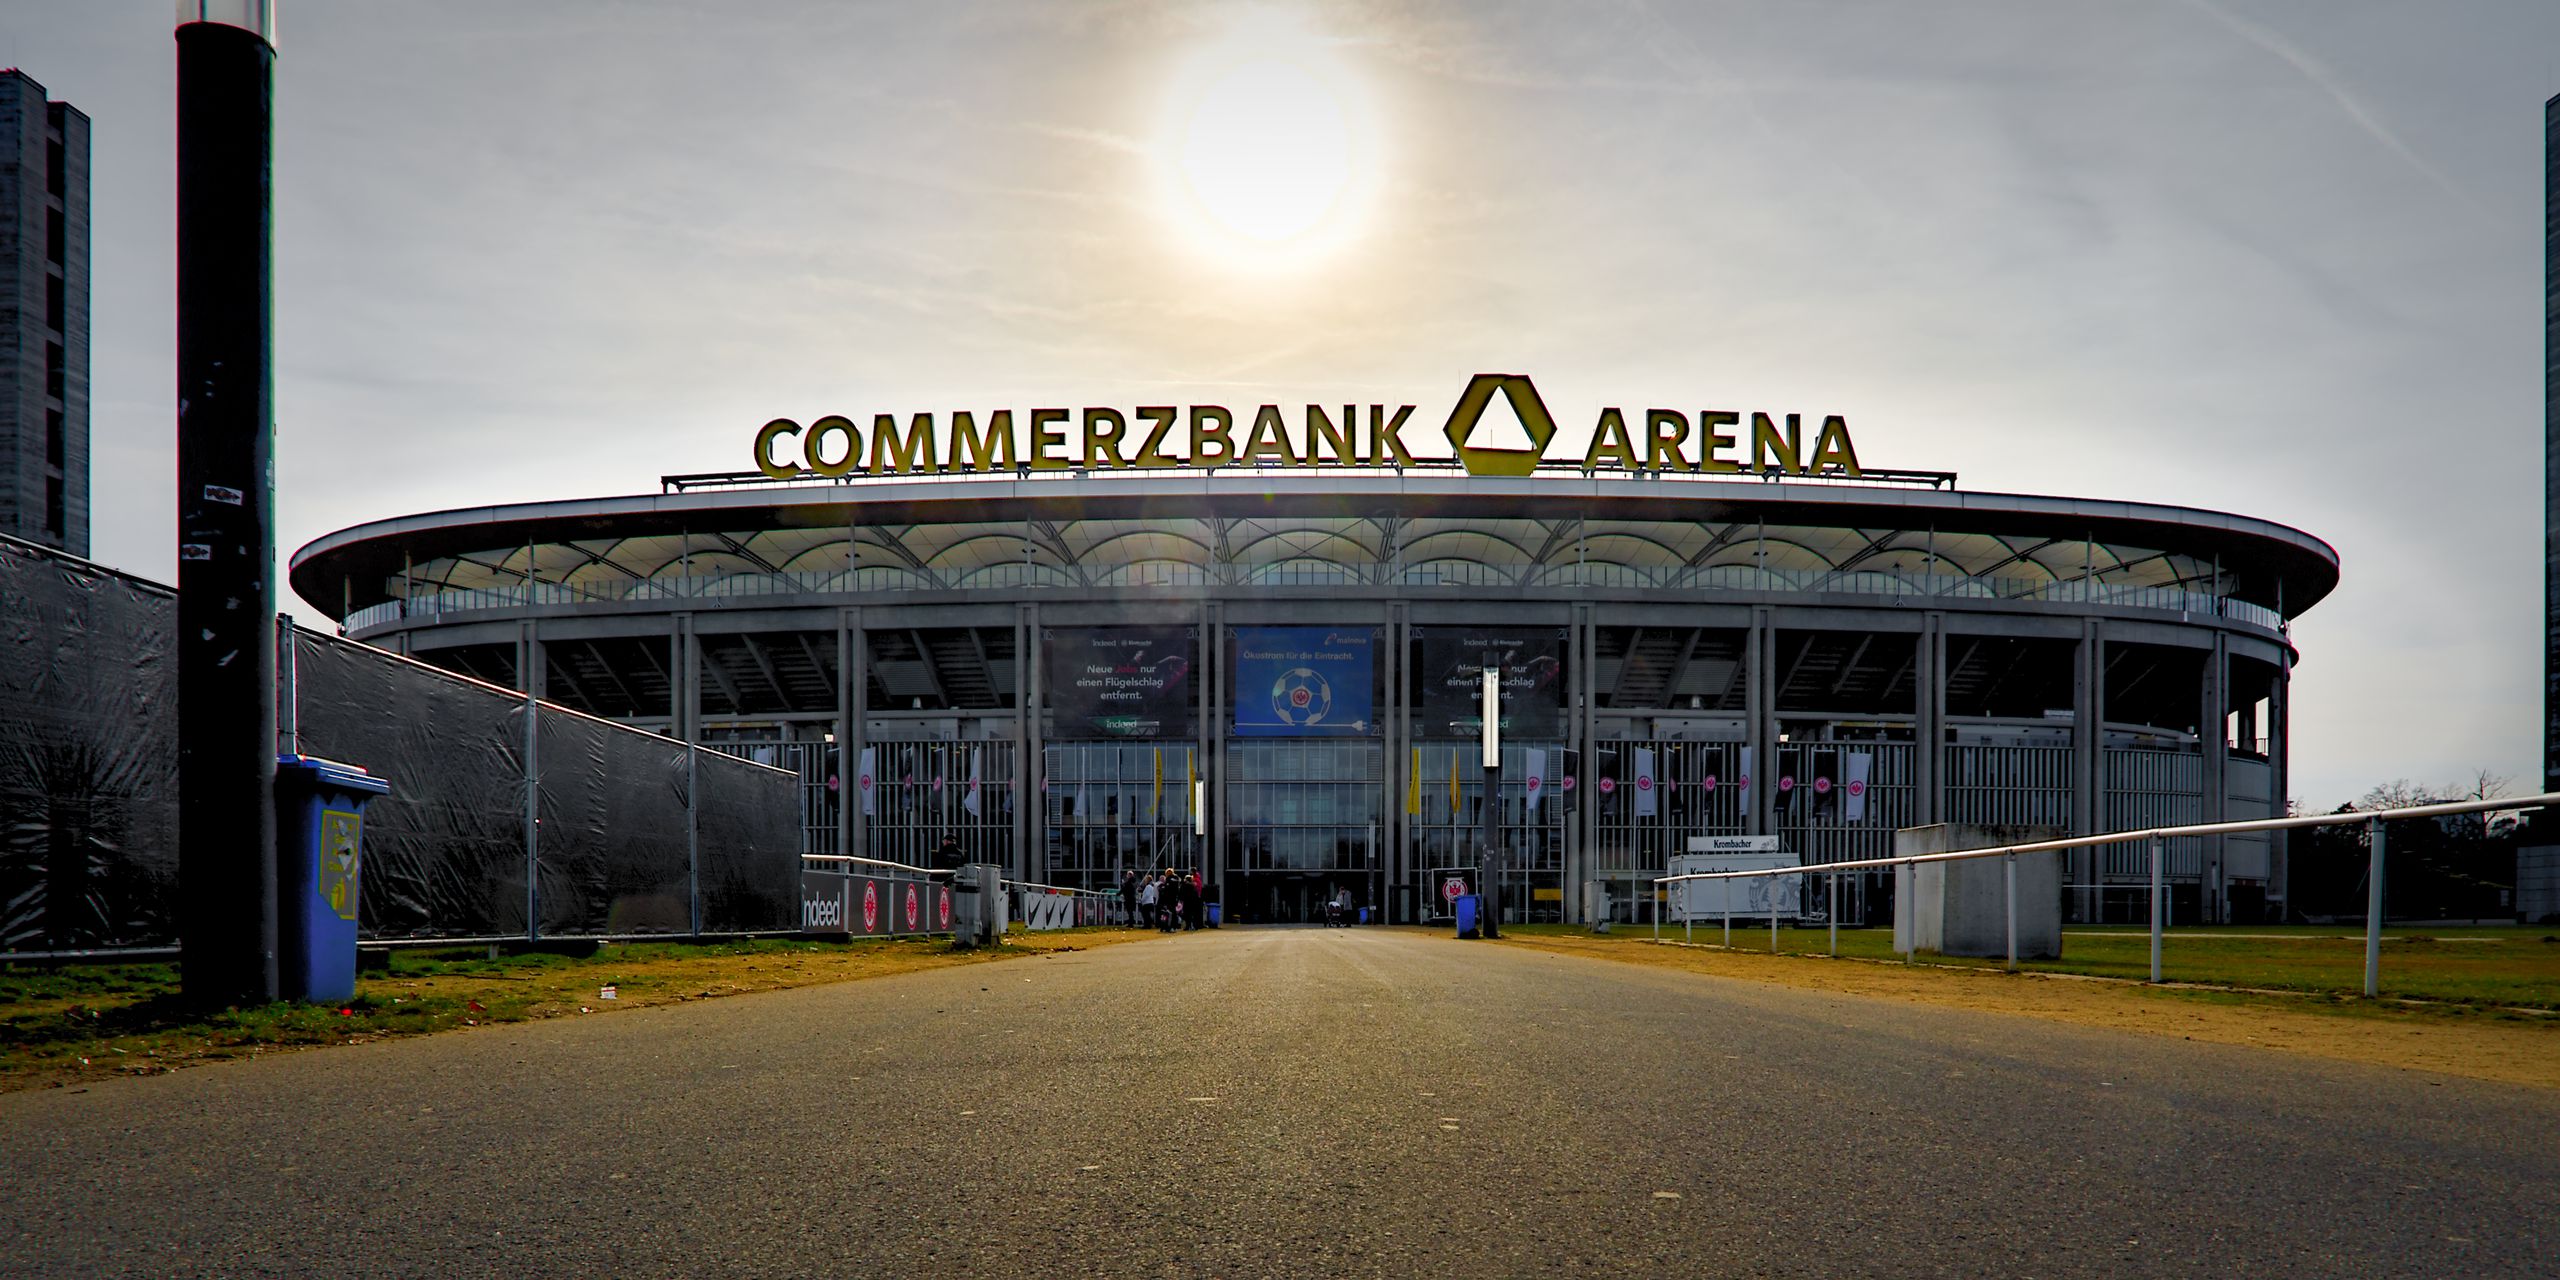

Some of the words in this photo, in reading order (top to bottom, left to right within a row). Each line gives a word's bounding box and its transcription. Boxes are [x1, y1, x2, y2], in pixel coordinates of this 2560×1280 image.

[753, 405, 1417, 479] COMMERZBANK
[1581, 407, 1863, 478] ARENA
[1286, 651, 1299, 659] für
[1299, 651, 1312, 659] die
[1315, 651, 1354, 659] Eintracht.
[1087, 665, 1113, 674] Neue
[1076, 678, 1103, 687] einen
[1105, 677, 1164, 689] Flügelschlag
[1447, 678, 1473, 687] einen
[1100, 691, 1143, 700] entfernt.
[1106, 720, 1137, 729] indeed
[1713, 839, 1752, 848] Krombacher
[802, 884, 841, 927] ndeed
